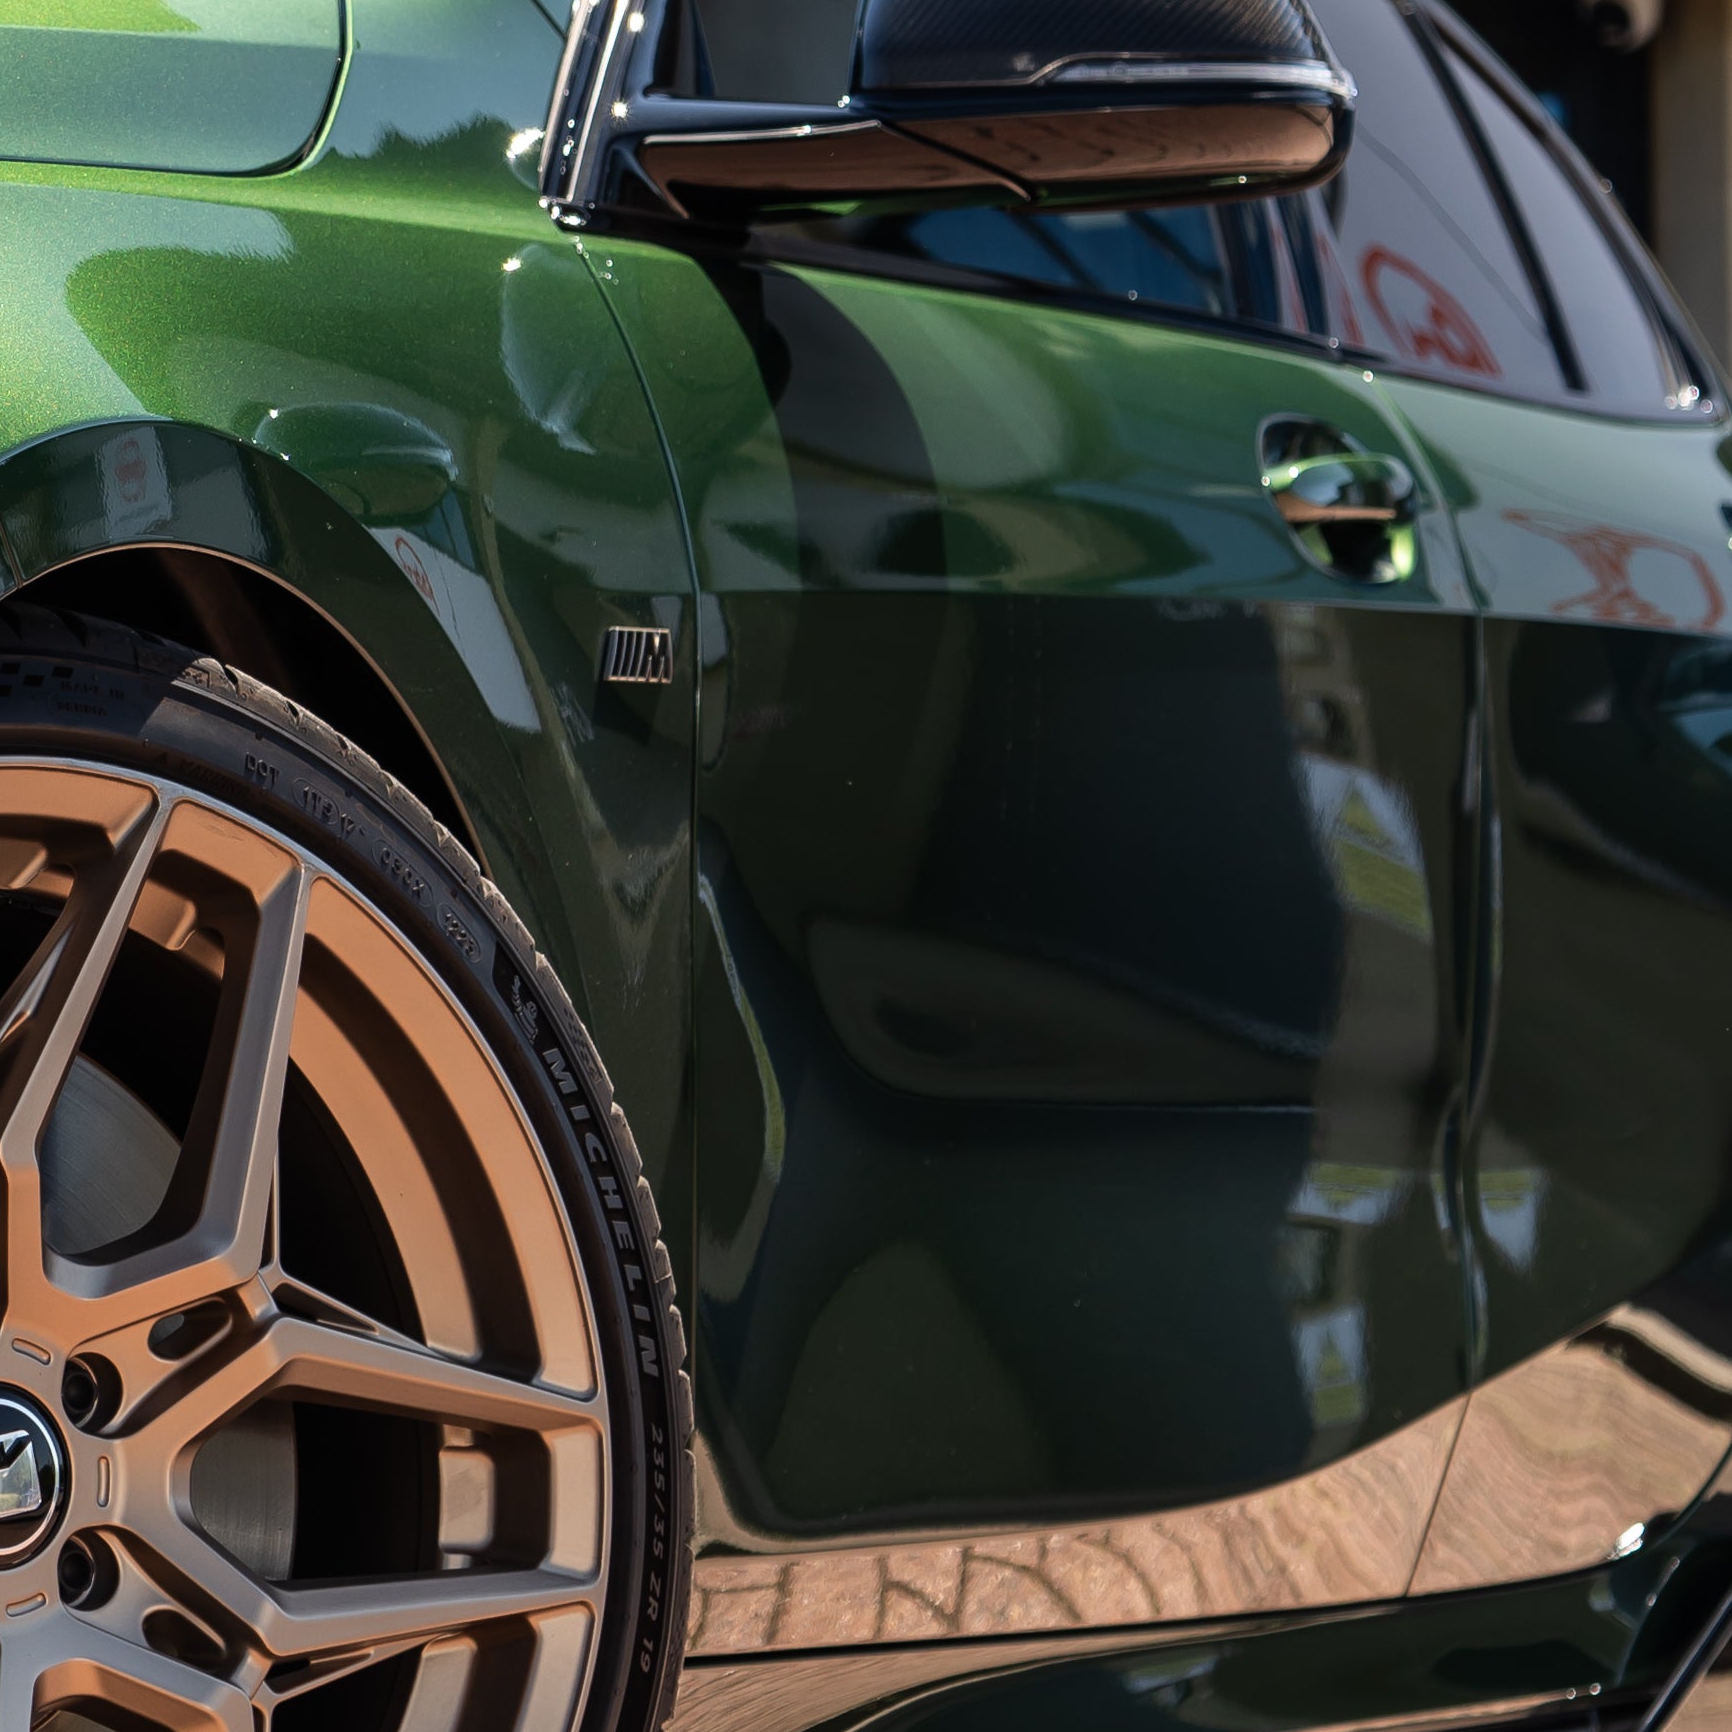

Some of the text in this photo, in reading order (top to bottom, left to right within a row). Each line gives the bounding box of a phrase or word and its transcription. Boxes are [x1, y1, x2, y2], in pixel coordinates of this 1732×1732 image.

[240, 750, 282, 786] DOT
[541, 1048, 667, 1675] MICHELIN 235/35 ZR 19
